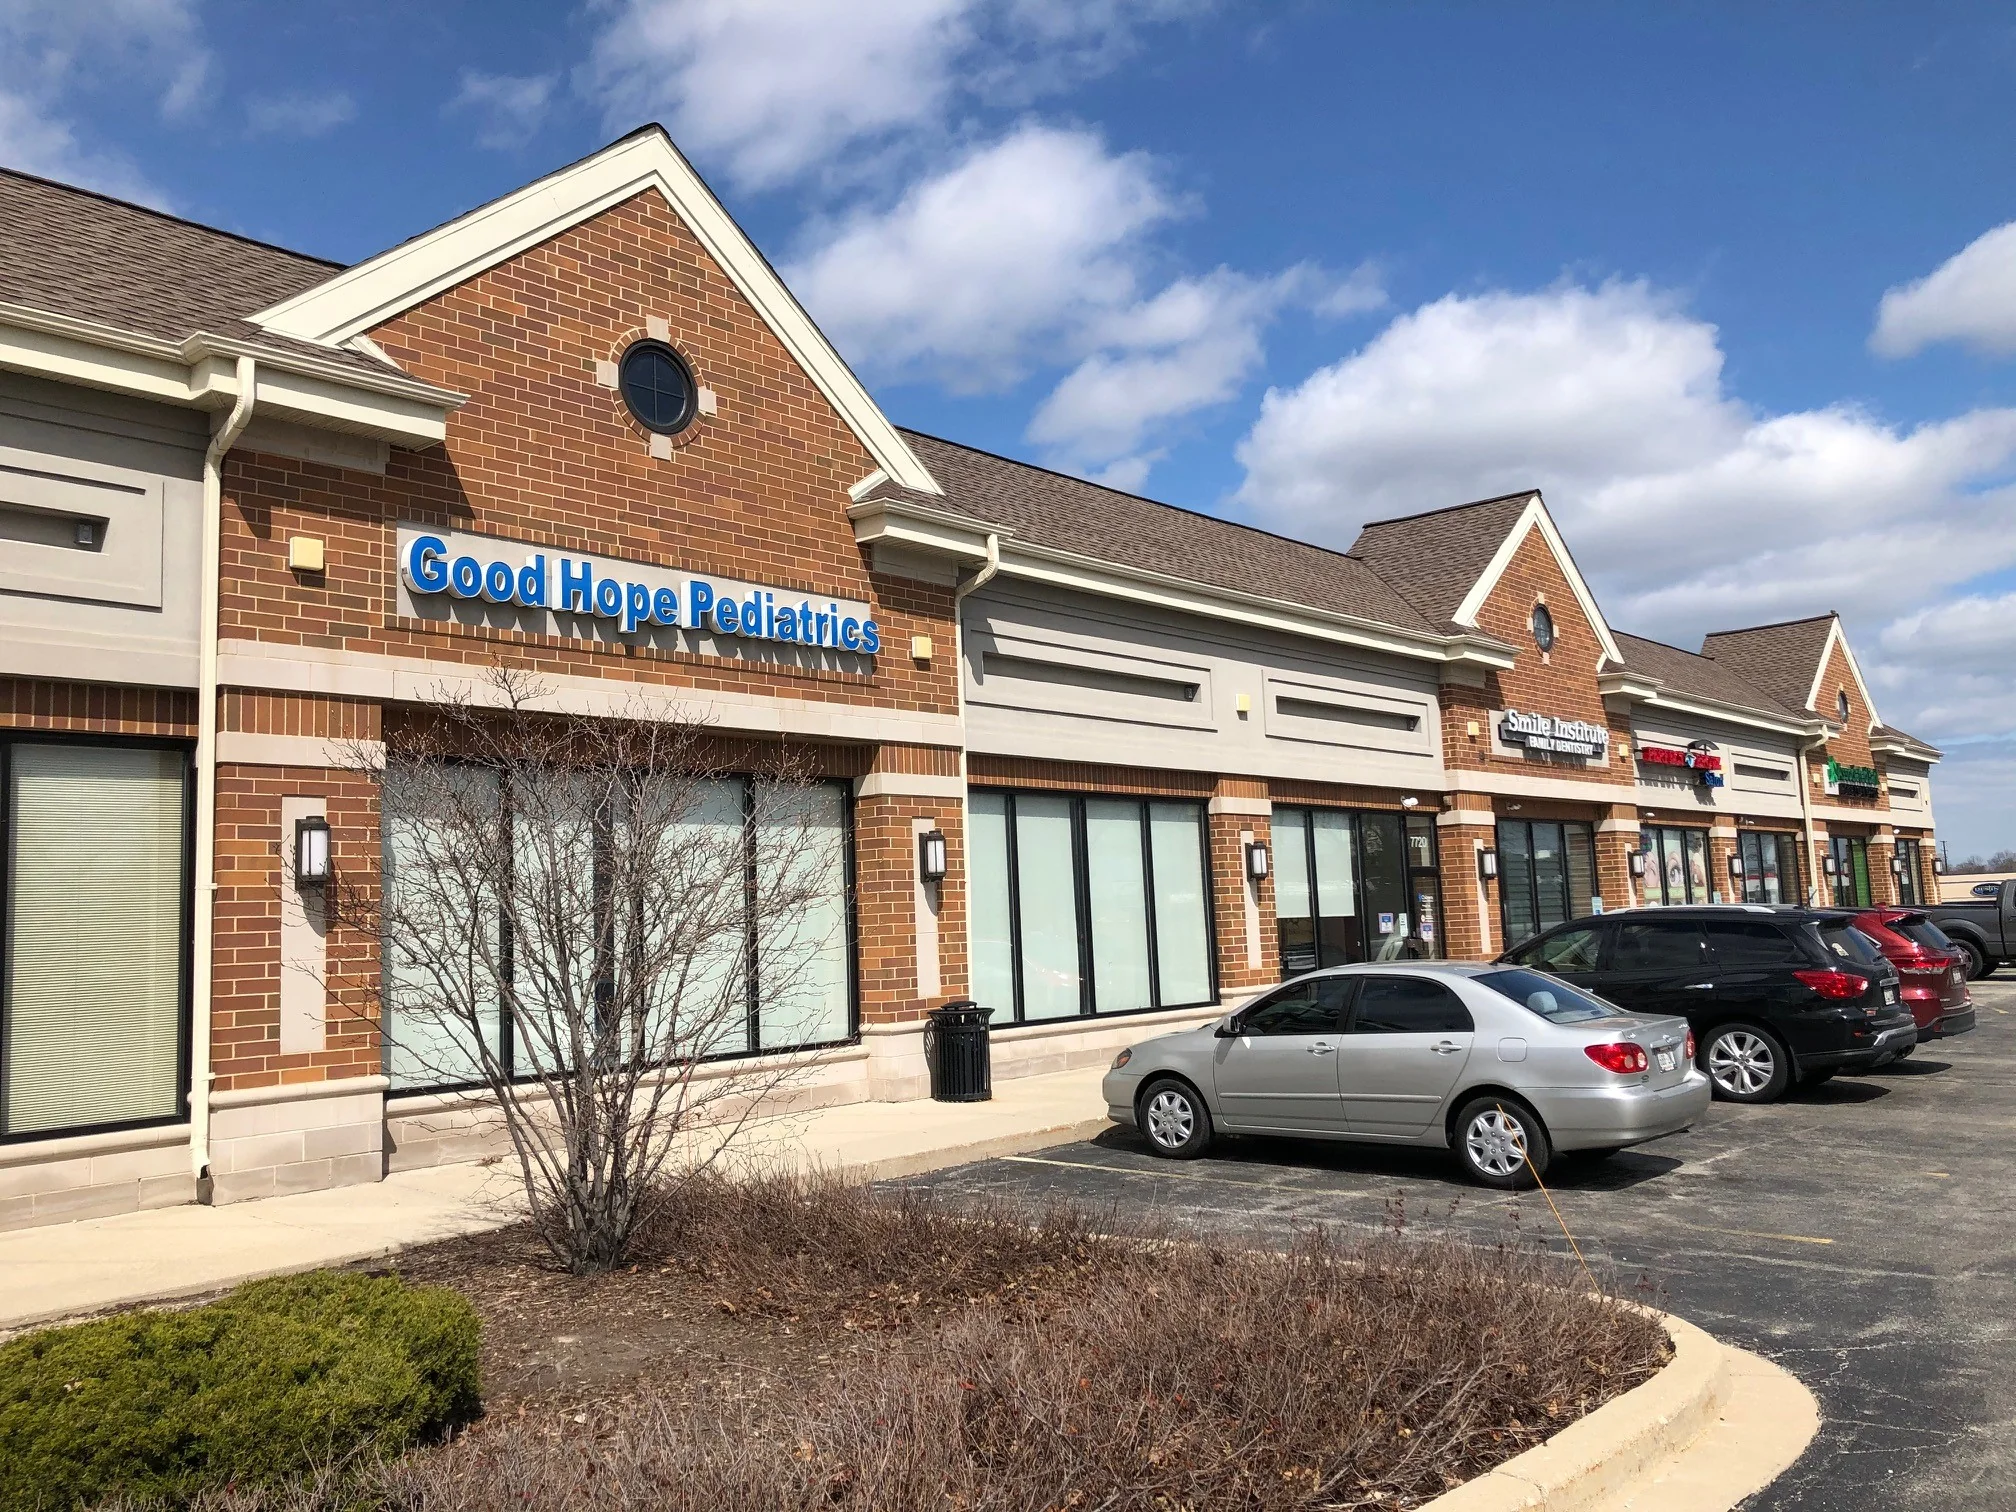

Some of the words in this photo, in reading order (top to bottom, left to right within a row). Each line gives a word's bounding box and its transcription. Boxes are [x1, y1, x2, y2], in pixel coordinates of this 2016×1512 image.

[404, 535, 547, 606] Good
[553, 557, 679, 632] Hope
[682, 580, 880, 654] Pediatrics
[1507, 708, 1551, 736] Smile
[1553, 716, 1609, 745] Institute
[1528, 735, 1555, 750] FAMILY
[1556, 739, 1593, 756] DENTISTRY
[1410, 836, 1427, 848] 7720
